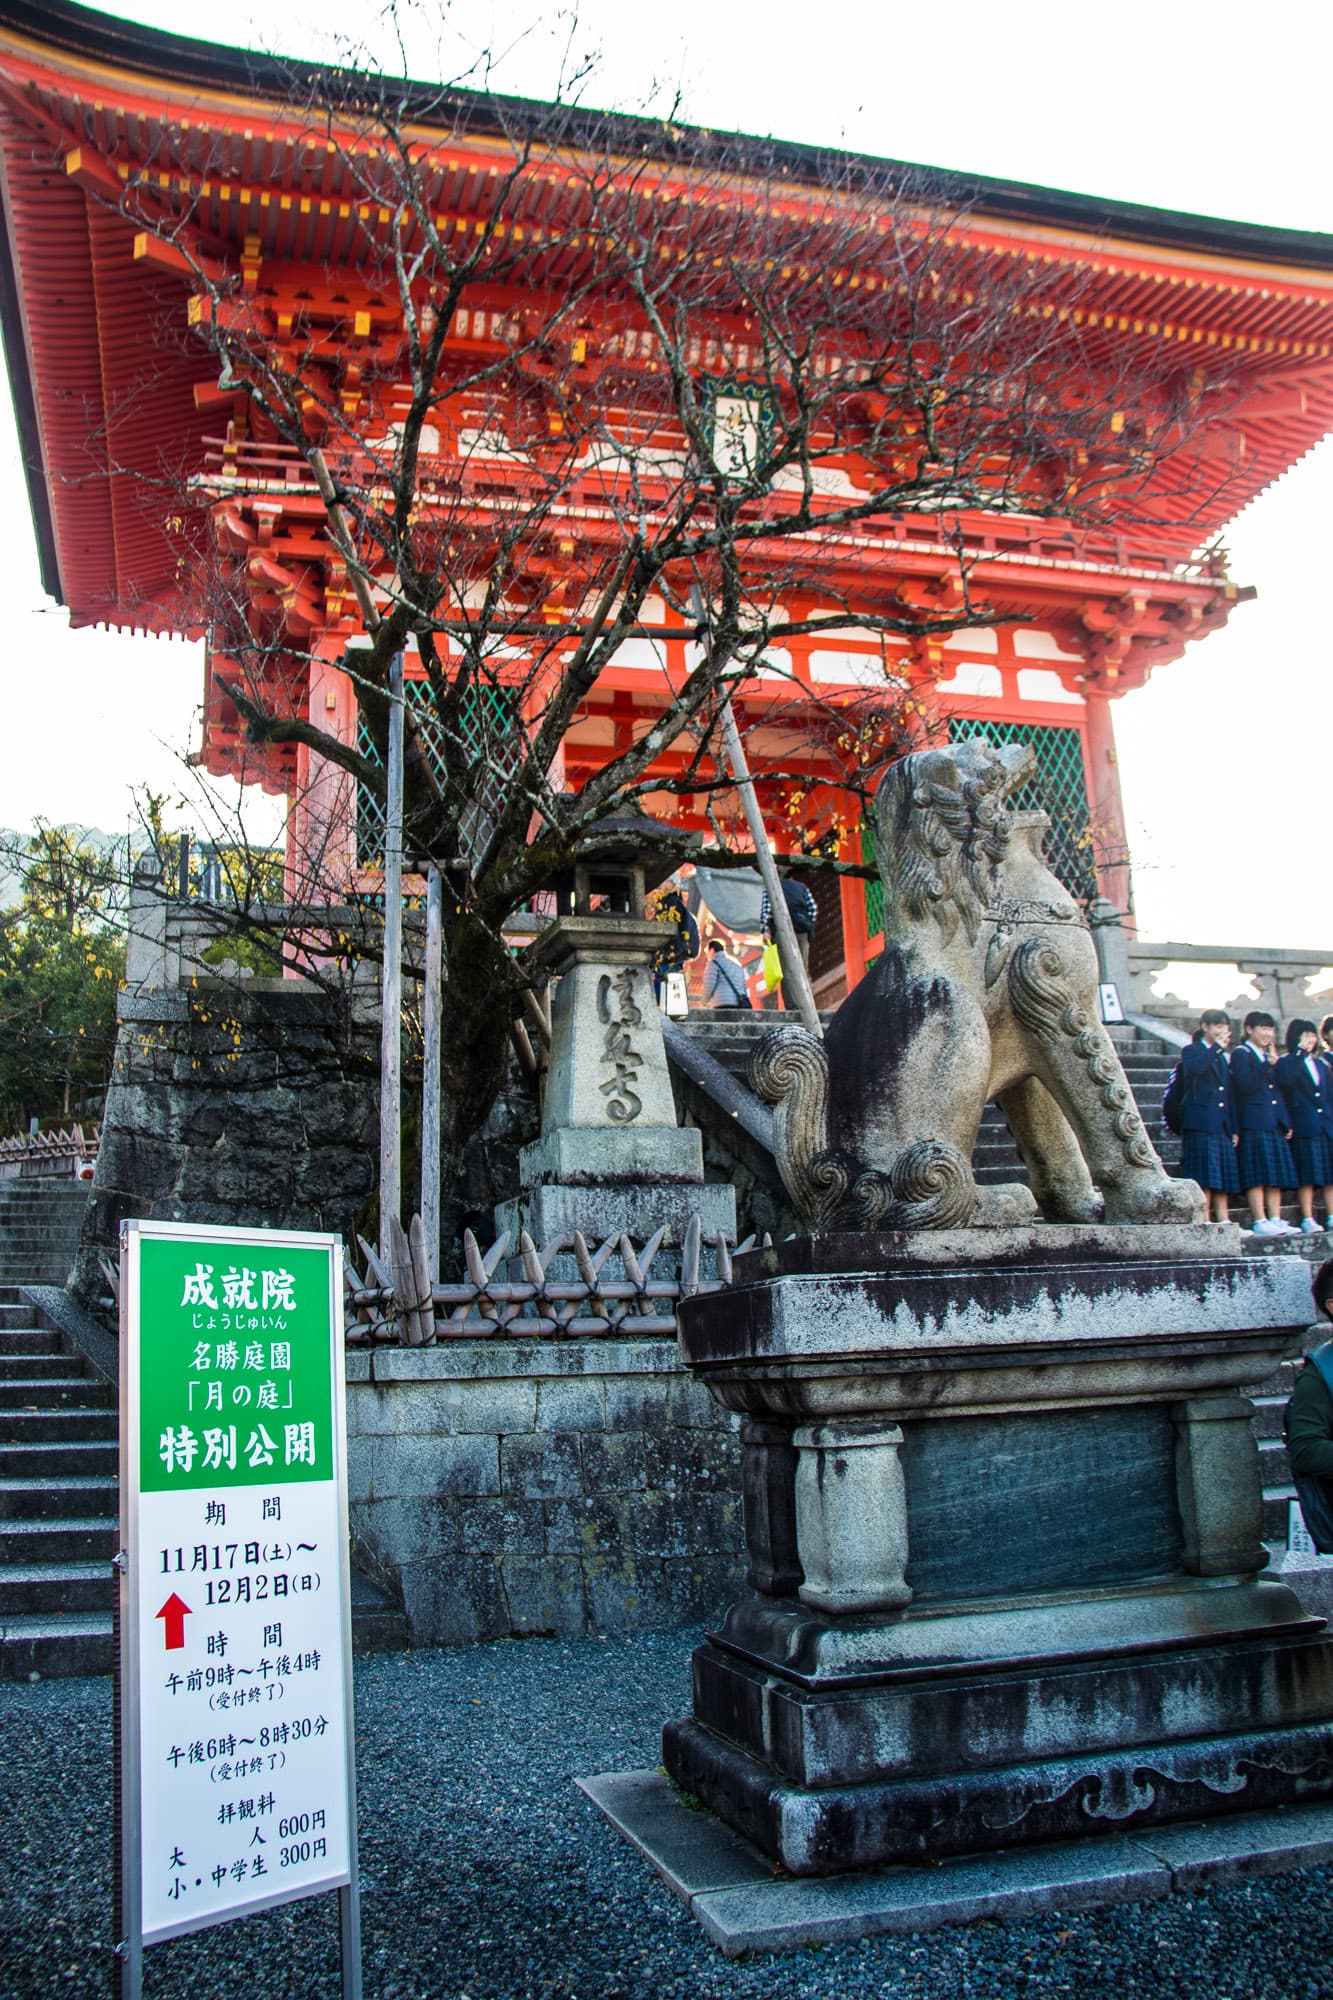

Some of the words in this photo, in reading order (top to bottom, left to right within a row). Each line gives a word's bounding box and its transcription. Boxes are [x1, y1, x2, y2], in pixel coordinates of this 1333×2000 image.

[180, 1262, 297, 1311] 成就院
[192, 1313, 287, 1330] じょうじゅいん
[188, 1340, 291, 1371] 名勝庭園
[188, 1379, 293, 1412] 「月の庭」
[159, 1421, 316, 1473] 特別公開
[205, 1573, 321, 1606] 12月2日(日)
[217, 1791, 276, 1825] 拝観料
[279, 1809, 326, 1839] 600円
[280, 1837, 327, 1867] 300円
